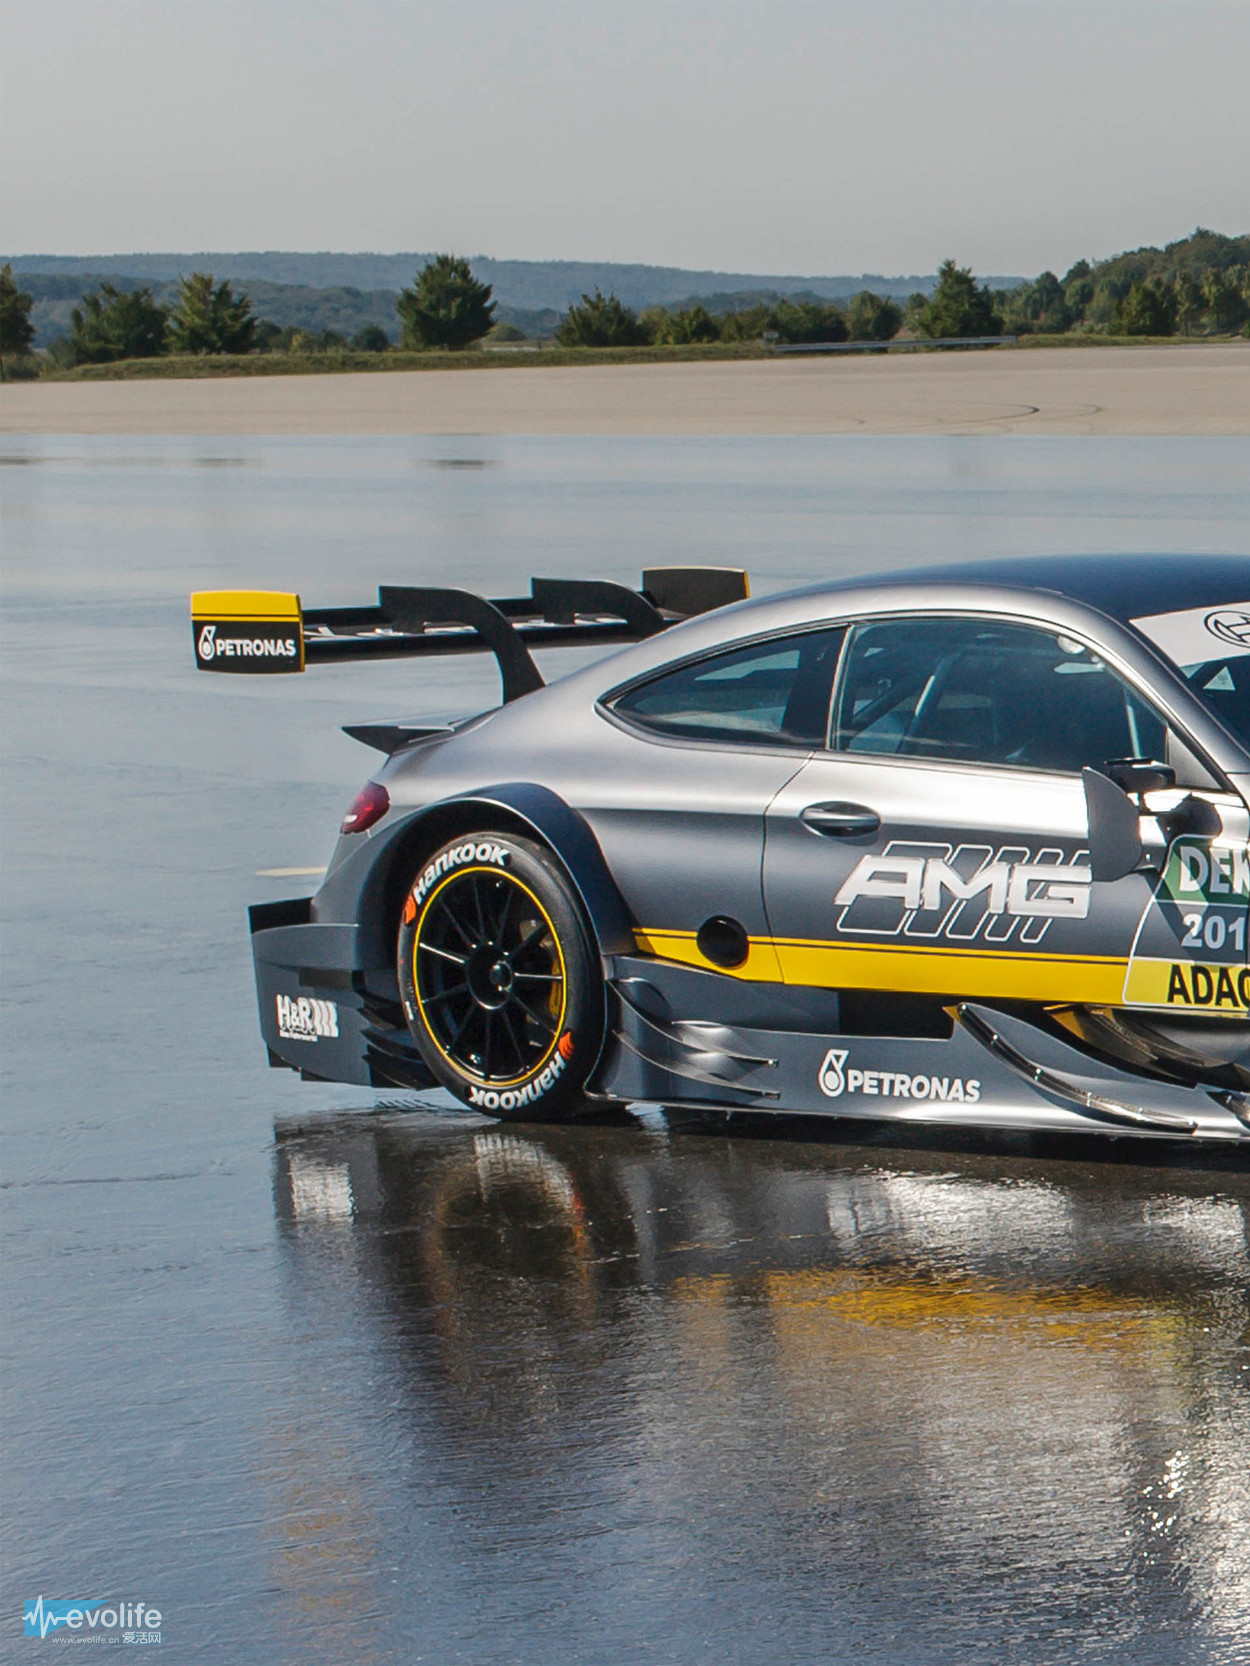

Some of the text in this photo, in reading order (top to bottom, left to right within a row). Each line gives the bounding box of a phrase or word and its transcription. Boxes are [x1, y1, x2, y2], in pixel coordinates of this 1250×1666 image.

[215, 638, 297, 657] PETRONAS
[834, 854, 1093, 919] AMG
[846, 1069, 981, 1103] PETRONAS
